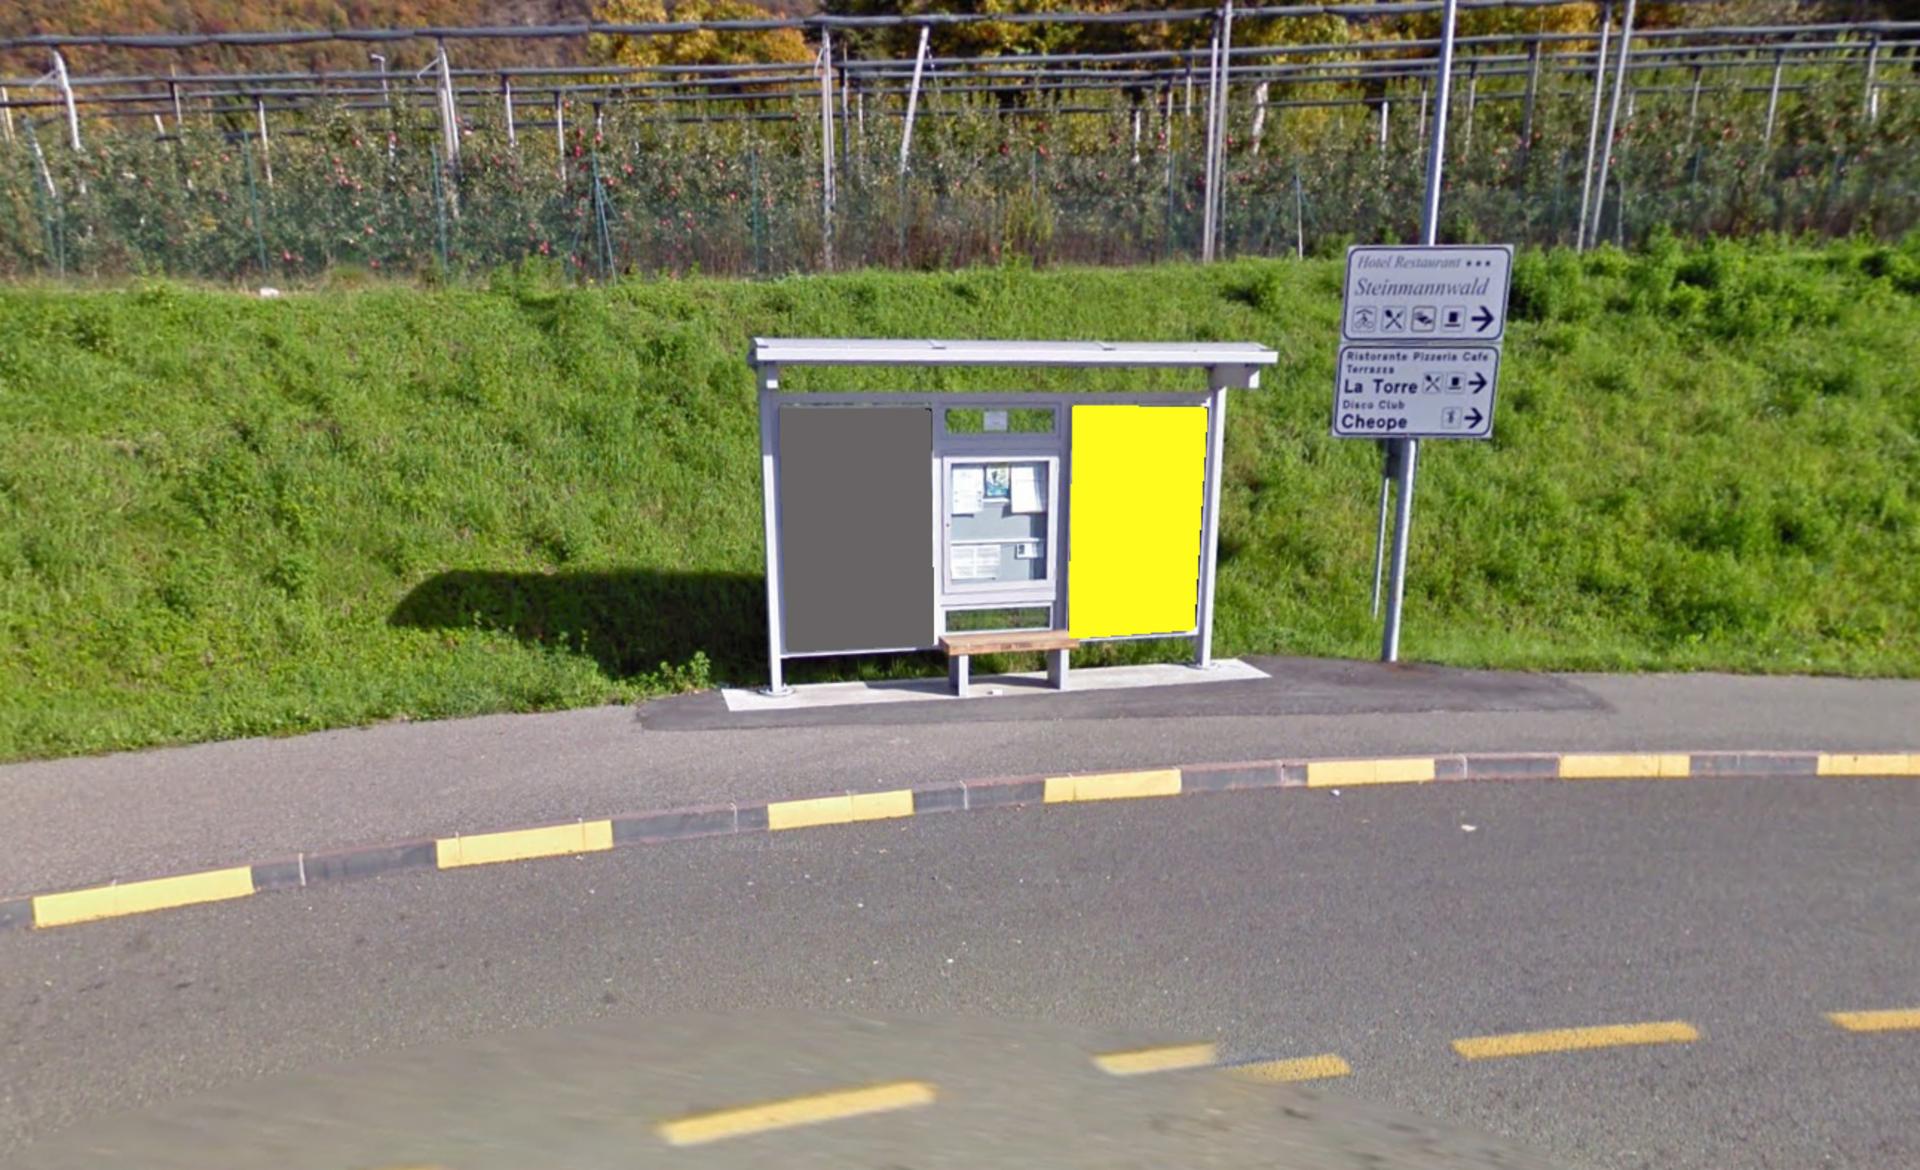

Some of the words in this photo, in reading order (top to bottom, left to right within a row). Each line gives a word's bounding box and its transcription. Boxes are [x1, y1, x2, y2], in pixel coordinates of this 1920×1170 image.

[1357, 255, 1392, 269] Hotel
[1394, 255, 1462, 269] Restaurant
[1355, 277, 1490, 296] Steinmannwald
[1346, 351, 1408, 362] Ristorante
[1412, 351, 1458, 362] Pizzeria
[1347, 364, 1395, 375] Terrazza
[1344, 379, 1363, 394] La
[1373, 379, 1418, 394] Torre
[1342, 399, 1374, 410] Disco
[1378, 399, 1405, 410] Club
[1341, 413, 1408, 431] Cheope
